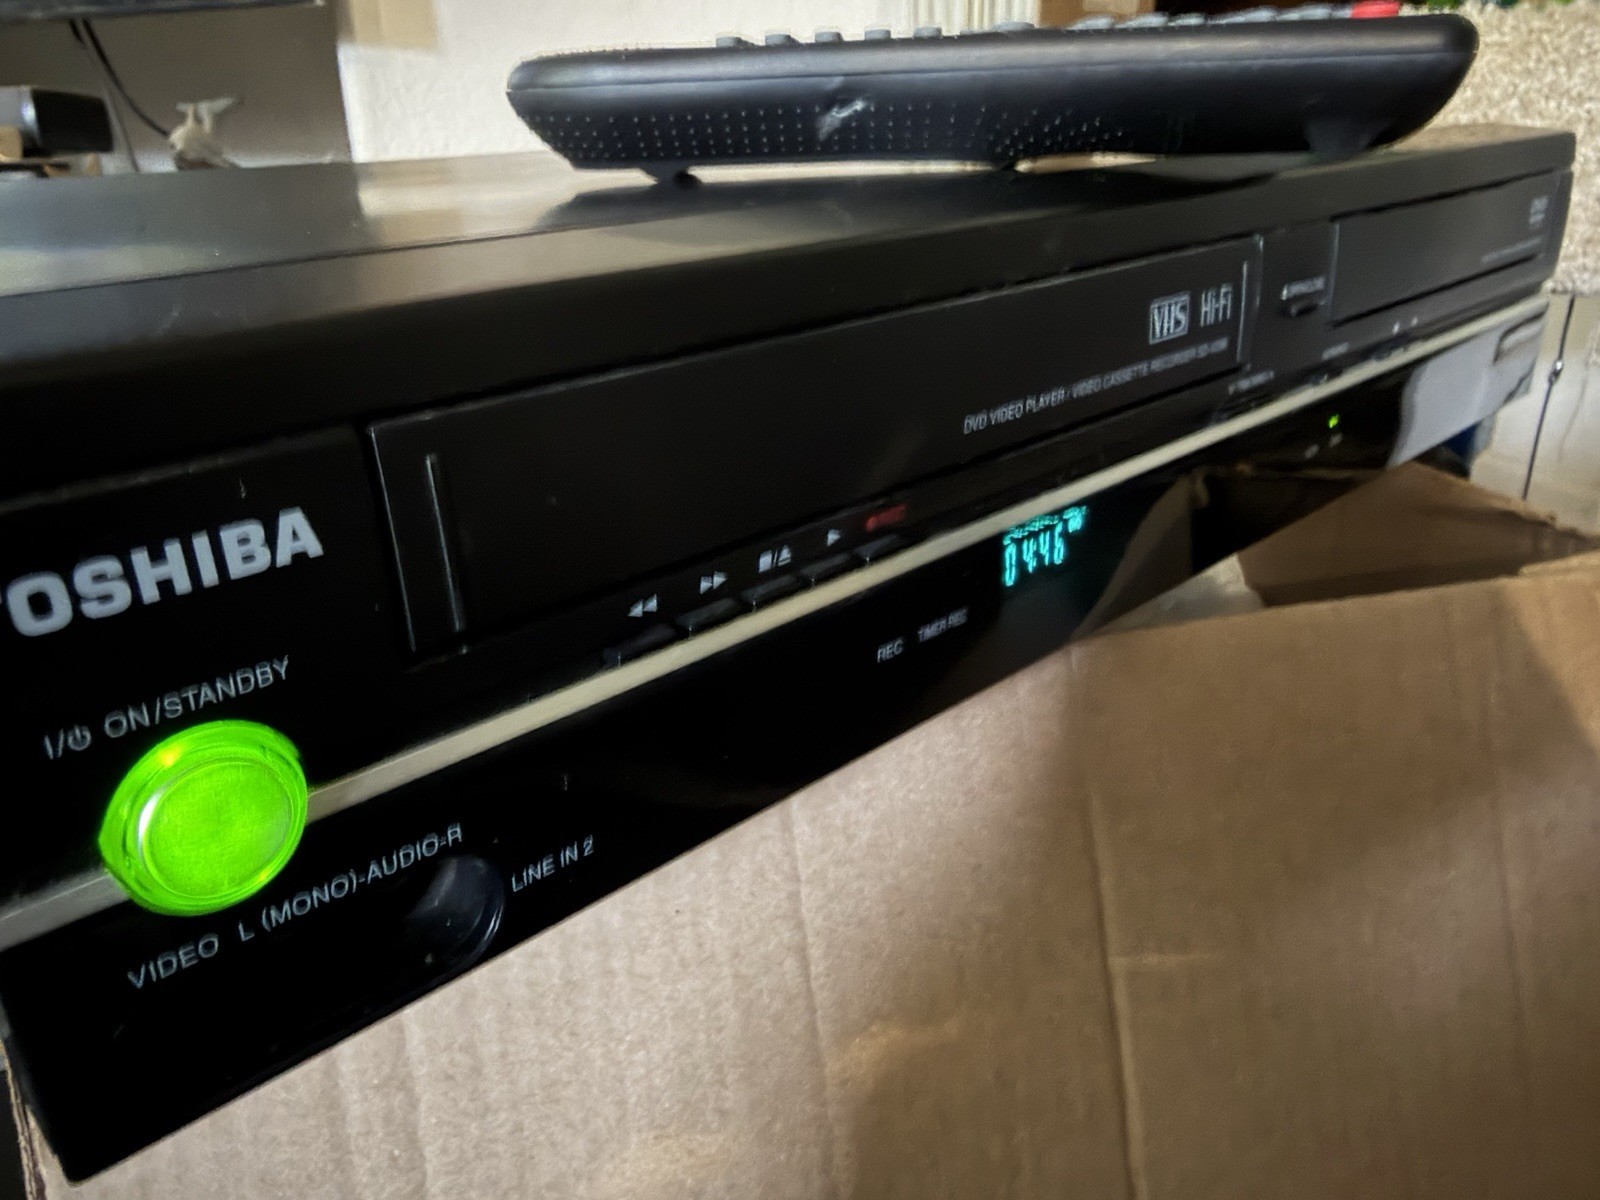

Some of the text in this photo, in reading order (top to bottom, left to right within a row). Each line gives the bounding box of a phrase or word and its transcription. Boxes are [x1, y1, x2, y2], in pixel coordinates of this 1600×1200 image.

[1150, 296, 1190, 342] VHS
[963, 410, 988, 435] DVD
[990, 400, 1023, 424] VIDEO
[1026, 387, 1065, 413] PLAYER
[0, 506, 324, 637] OSHIBA
[104, 655, 289, 738] ON/STANDBY
[511, 834, 594, 892] LINE IN 2
[127, 933, 219, 989] VIDEO
[238, 921, 256, 942] L
